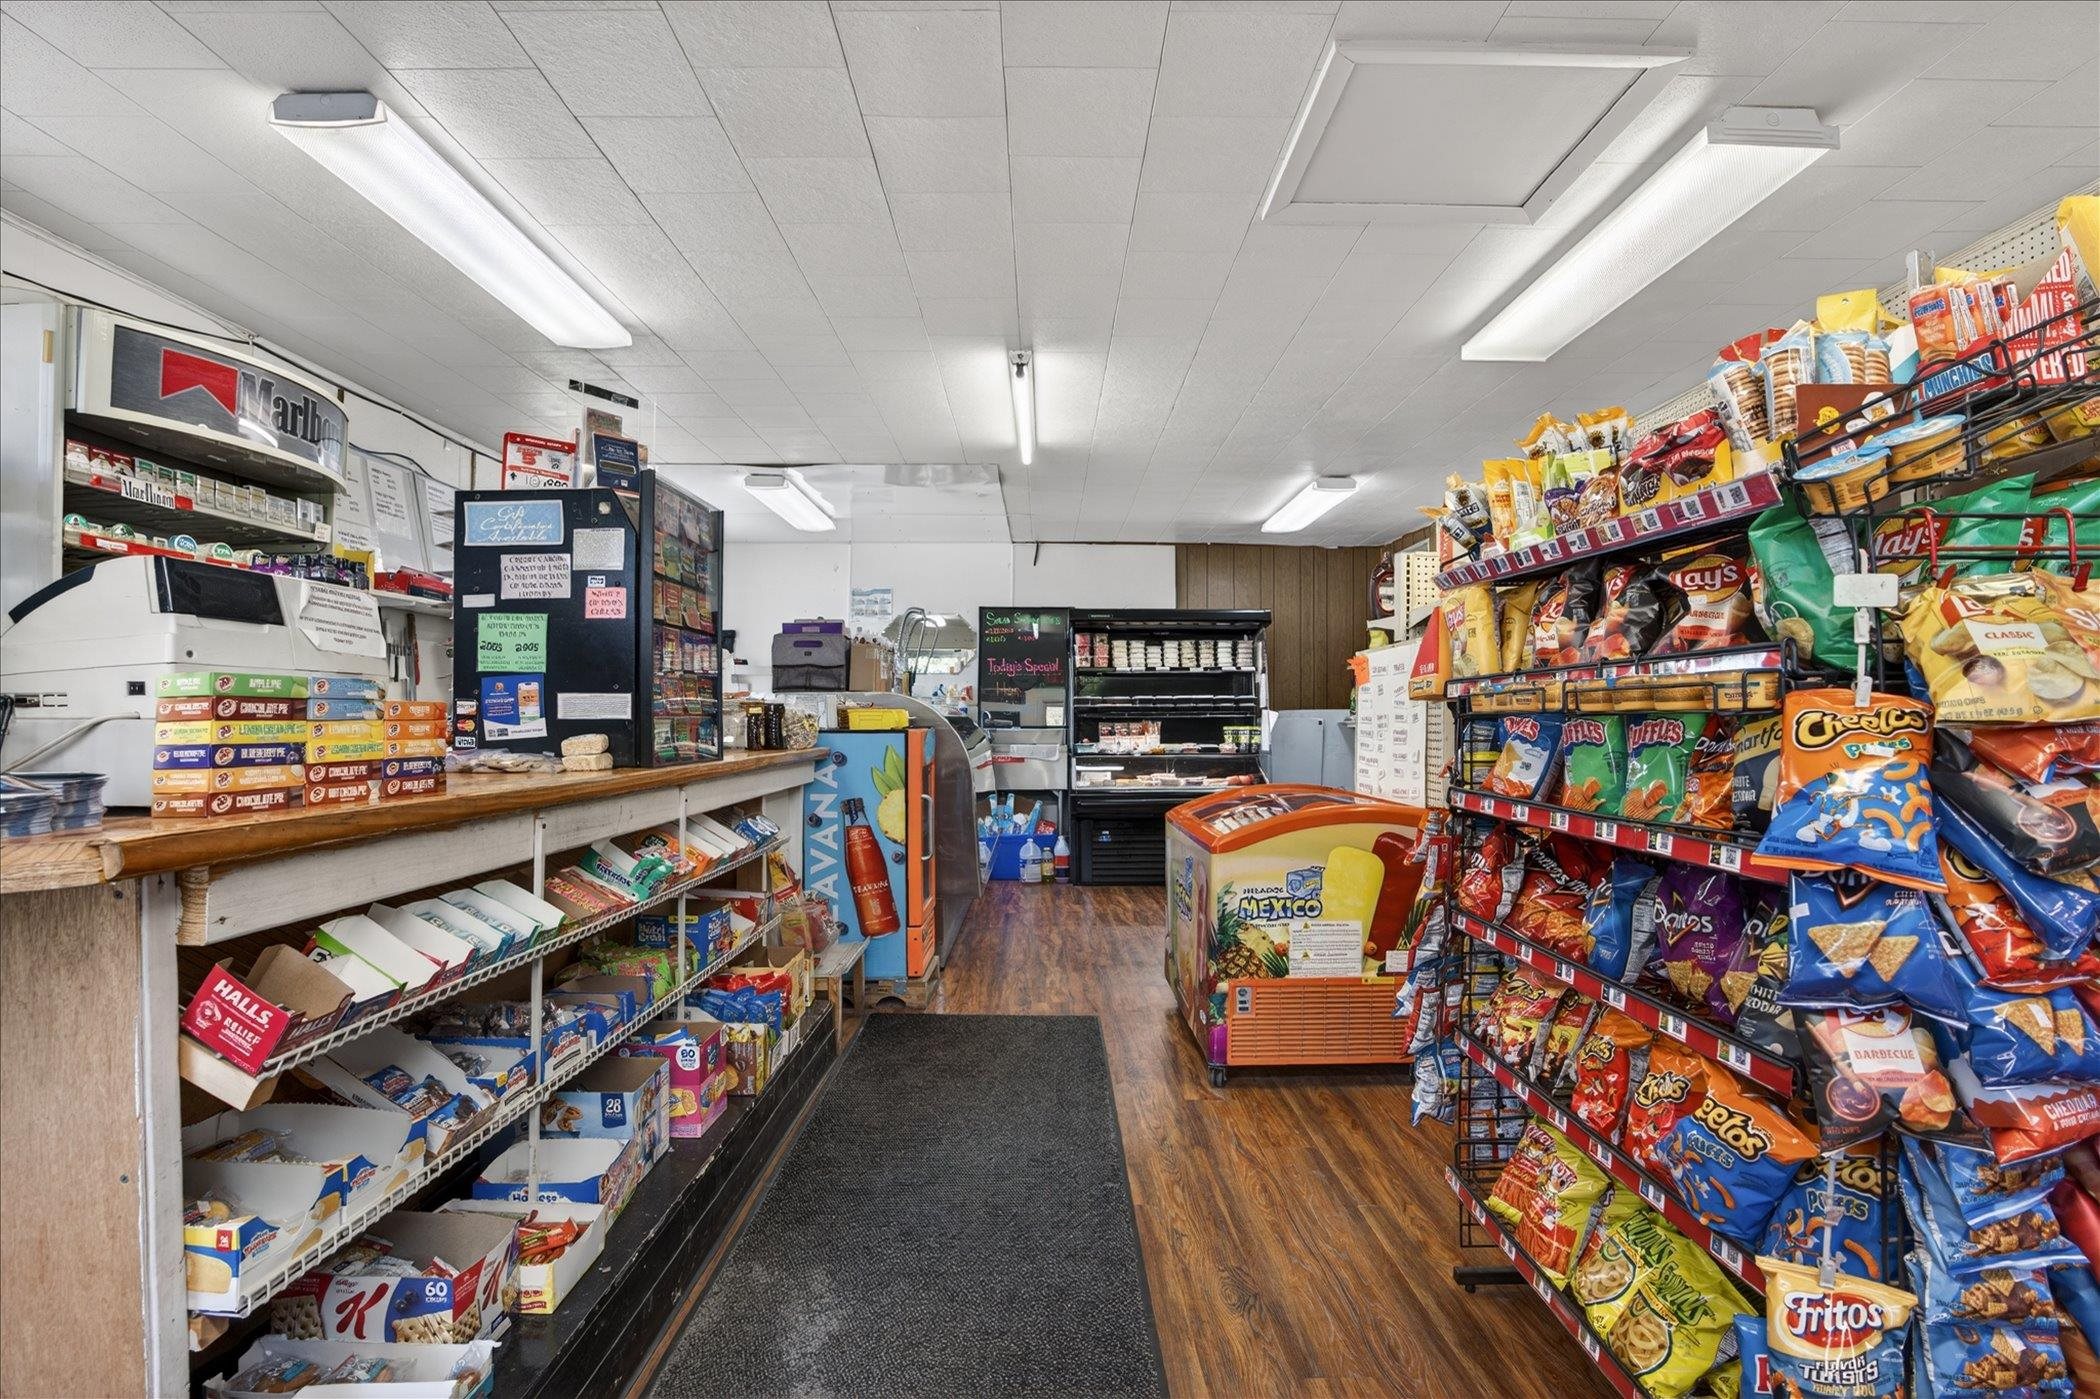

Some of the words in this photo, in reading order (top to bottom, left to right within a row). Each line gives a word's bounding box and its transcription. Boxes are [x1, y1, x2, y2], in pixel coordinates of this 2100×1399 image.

[1675, 563, 1738, 591] Lay's
[1985, 631, 2036, 640] CLASSIC
[987, 658, 1023, 677] Today's
[1025, 658, 1059, 676] Special
[1563, 719, 1606, 747] UFFLES
[1628, 718, 1684, 749] UFFLES
[1797, 707, 1925, 748] Cheetos
[1238, 896, 1323, 921] MEXICO
[1653, 896, 1714, 934] Doritos
[223, 1017, 262, 1046] RELIEF
[1854, 1048, 1916, 1061] BARBECUE
[605, 1098, 621, 1114] 28
[1694, 1098, 1765, 1159] eetos
[425, 1281, 447, 1297] 60
[335, 1282, 390, 1340] K
[1785, 1291, 1884, 1335] Fritos
[1800, 1360, 1879, 1384] TWISTS
